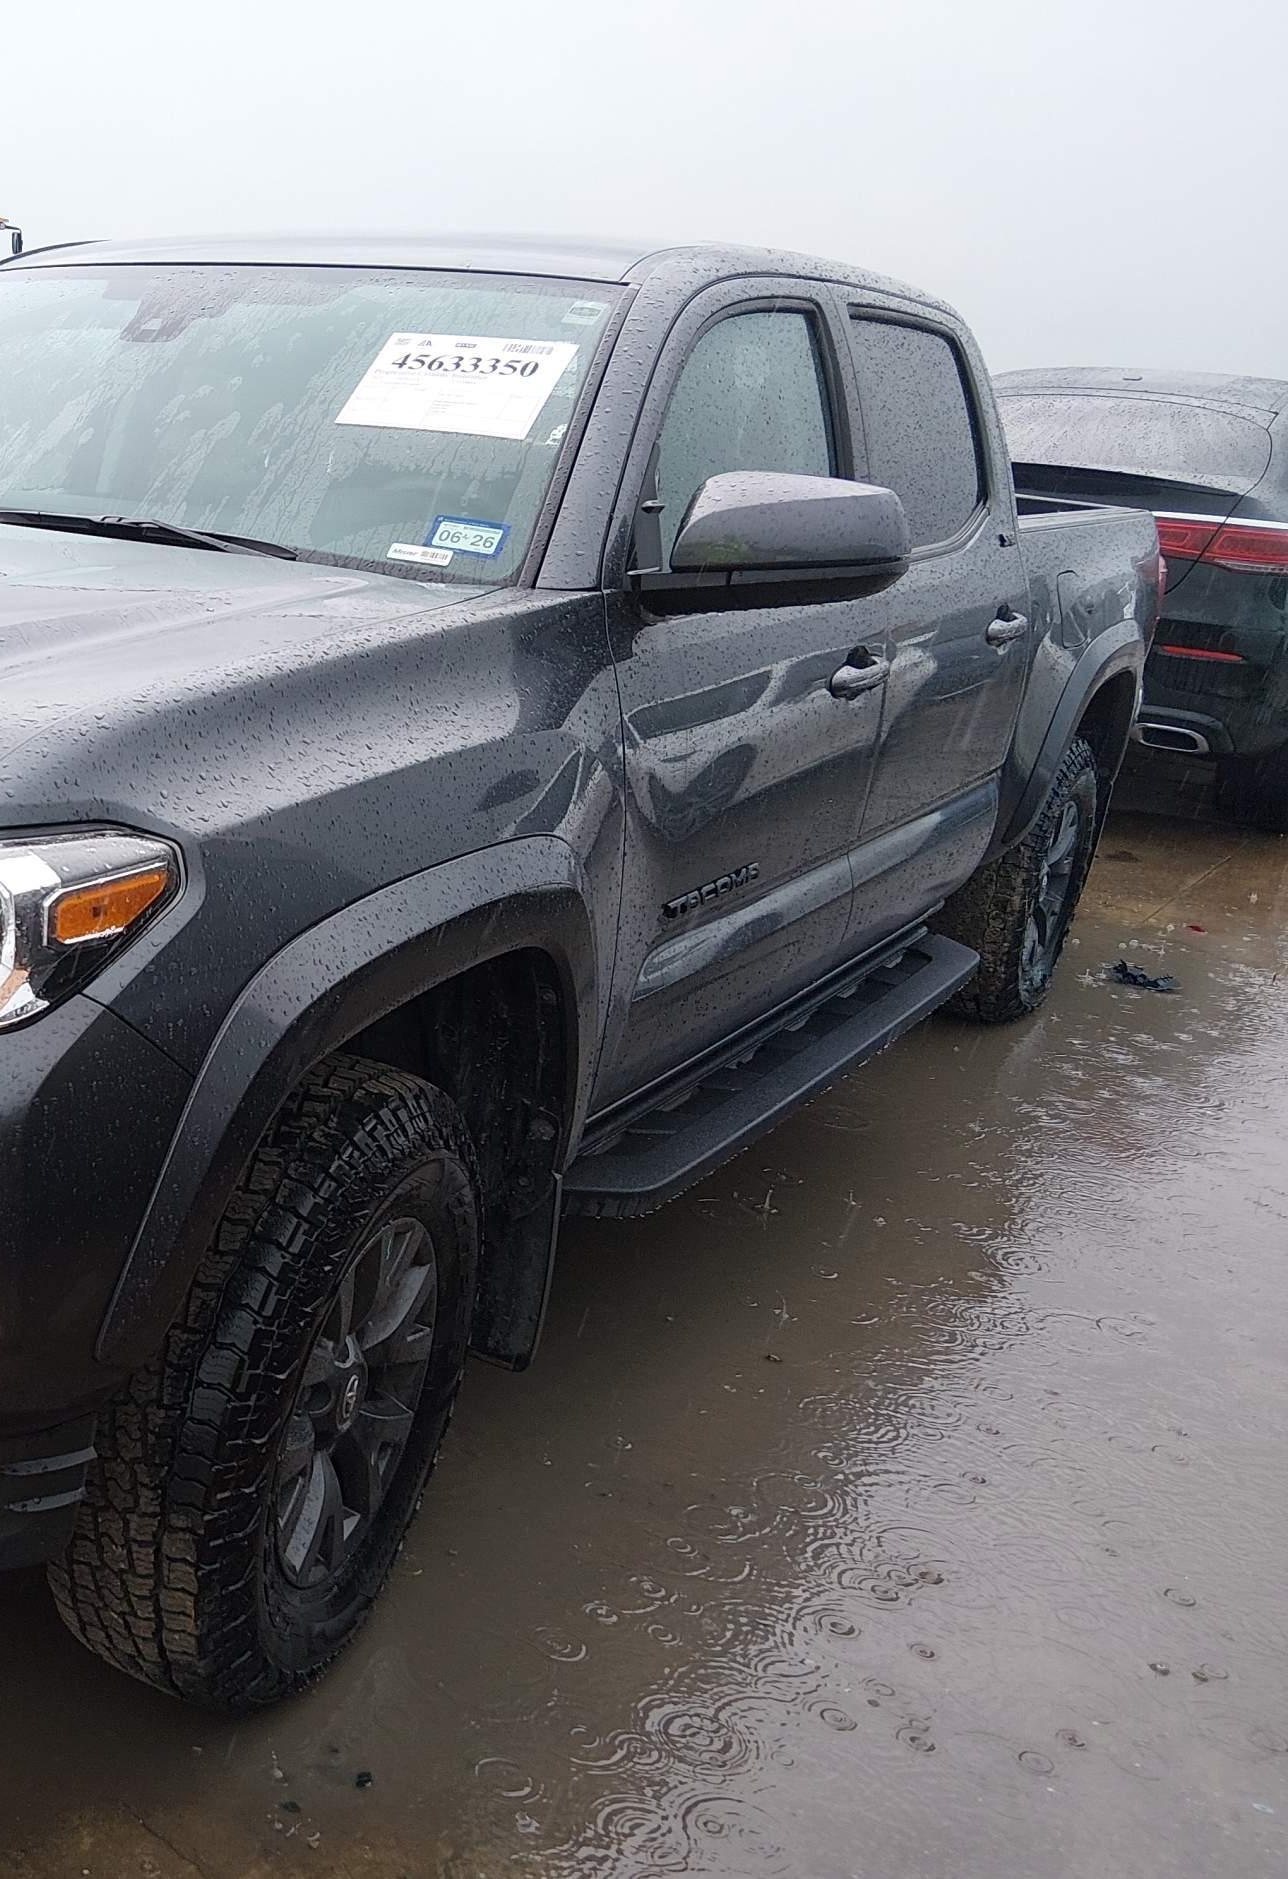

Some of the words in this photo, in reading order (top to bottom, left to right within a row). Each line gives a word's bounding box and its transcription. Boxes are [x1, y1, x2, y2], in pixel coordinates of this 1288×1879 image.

[391, 352, 539, 378] 45633350
[438, 529, 463, 544] 06
[470, 534, 497, 549] 26
